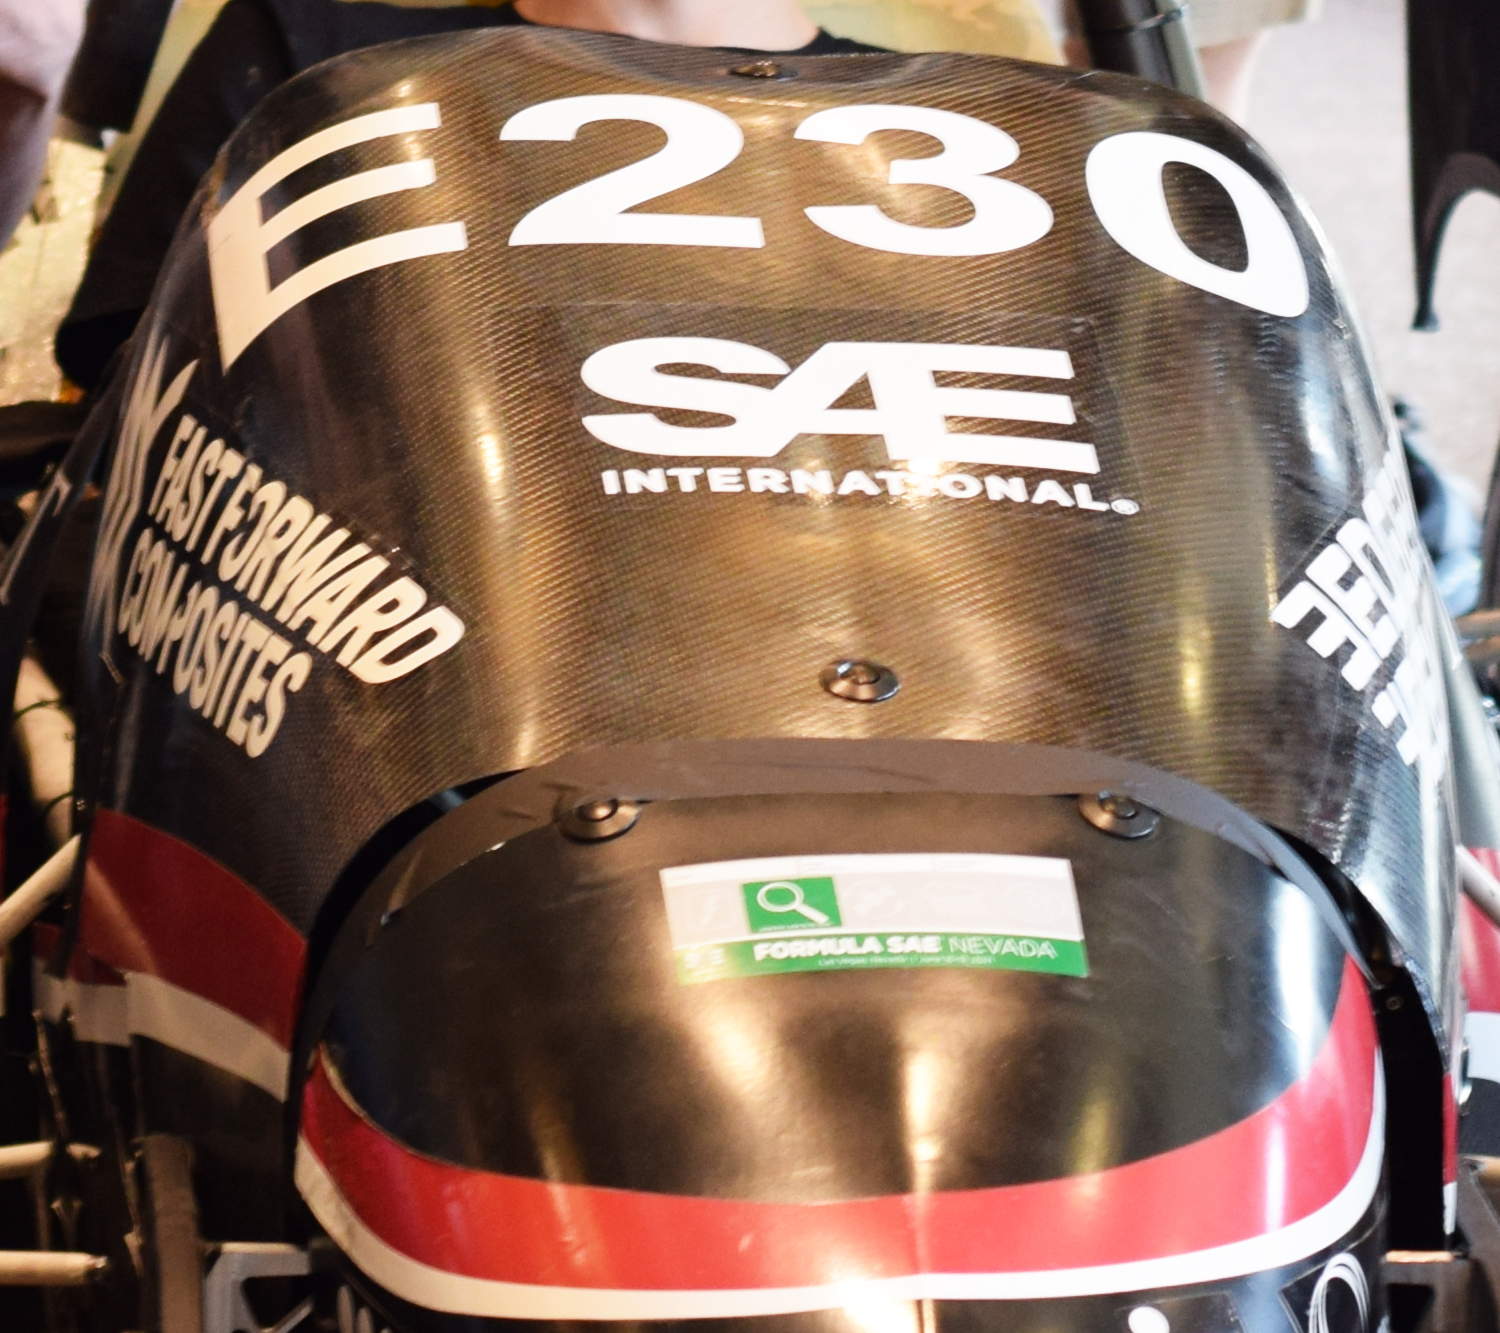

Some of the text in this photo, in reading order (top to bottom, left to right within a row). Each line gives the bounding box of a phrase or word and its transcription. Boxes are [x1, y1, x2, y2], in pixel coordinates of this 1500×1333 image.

[208, 93, 1310, 376] E230
[580, 335, 1101, 476] SAE
[118, 527, 313, 759] COMPOSITES
[752, 934, 885, 962] FORMULA
[886, 935, 942, 955] SAE
[949, 936, 1059, 961] NEVADA
